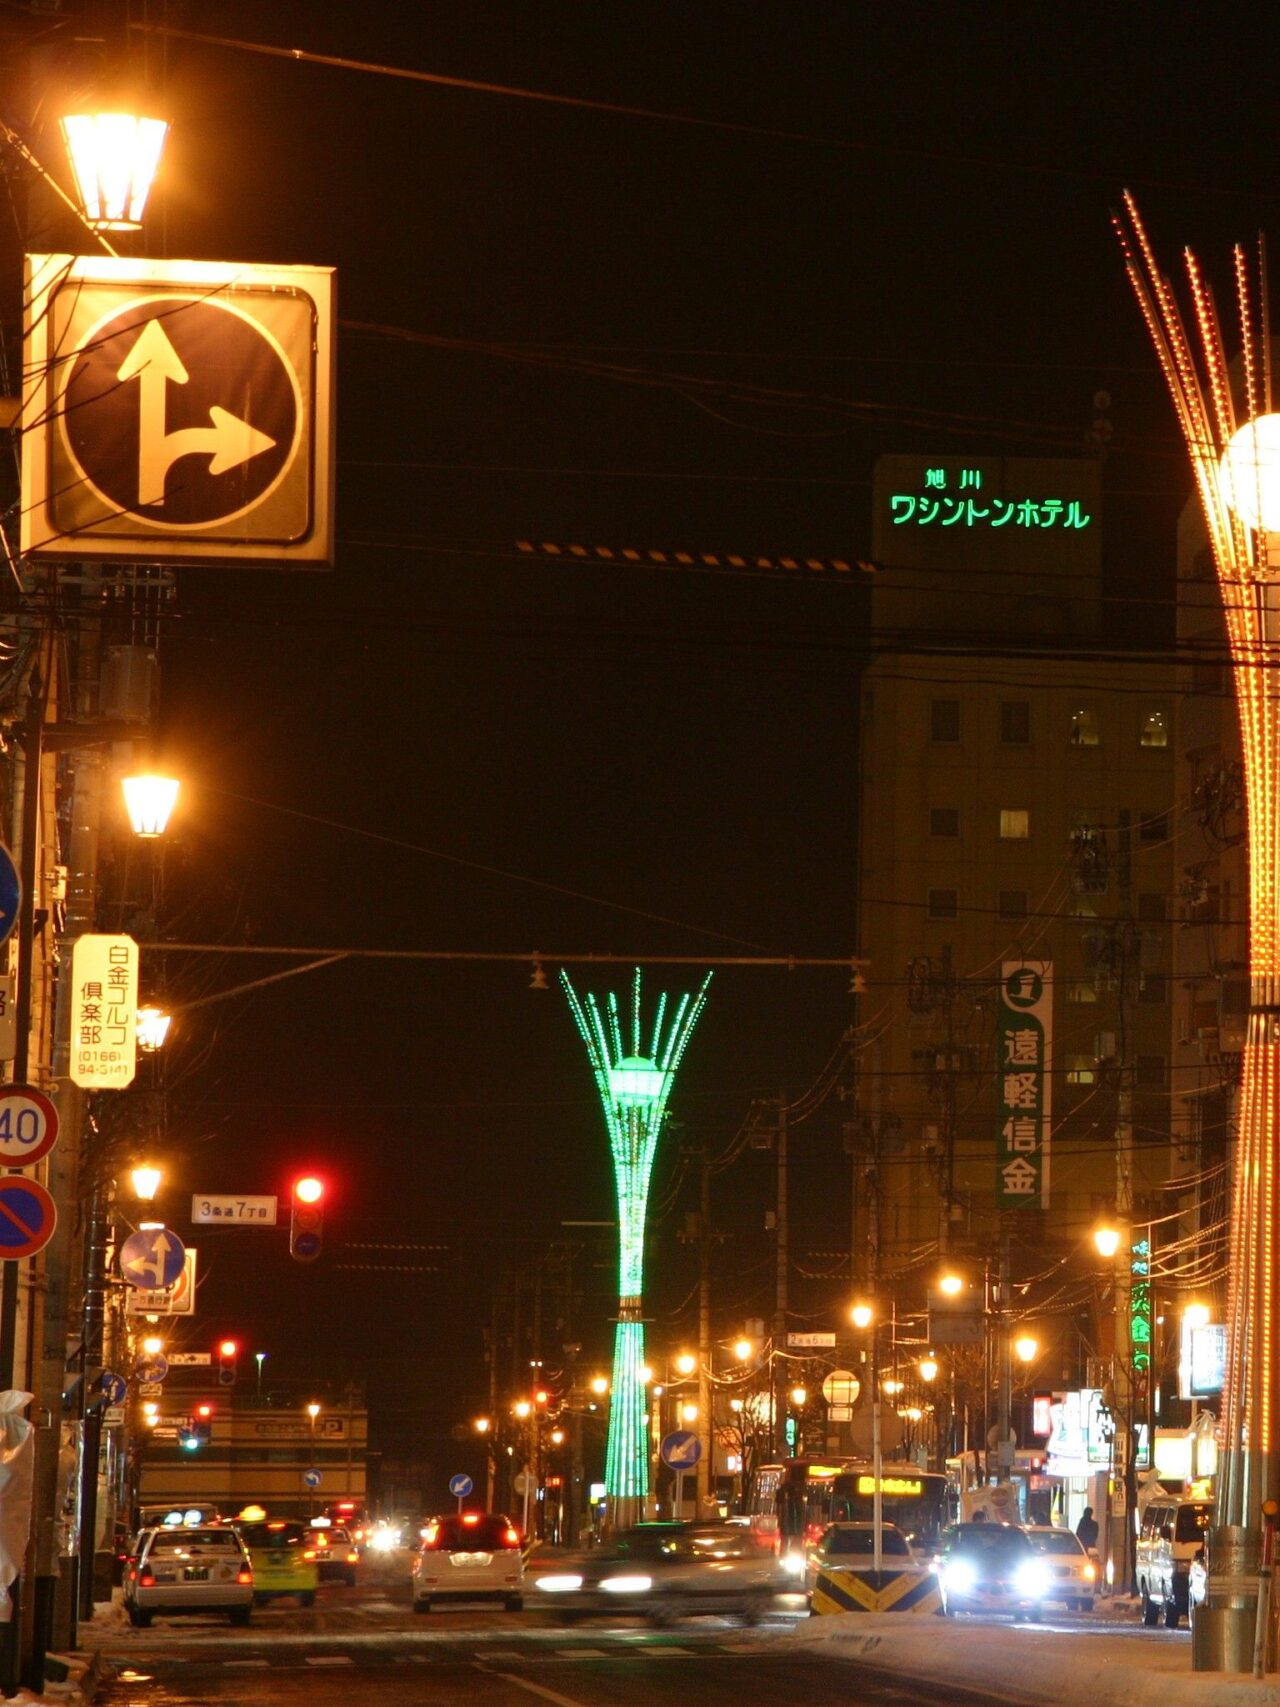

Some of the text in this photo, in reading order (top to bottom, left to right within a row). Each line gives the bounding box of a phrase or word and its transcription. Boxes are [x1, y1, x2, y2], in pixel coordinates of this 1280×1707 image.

[925, 468, 980, 490] 旭川
[891, 495, 1090, 529] ワシントンホテル
[106, 945, 130, 1046] 白金ゴルフ
[78, 1050, 121, 1062] (0166)
[0, 1108, 39, 1144] 40
[1002, 1029, 1039, 1195] 遠軽信金
[201, 1201, 267, 1218] 3条通7丁目
